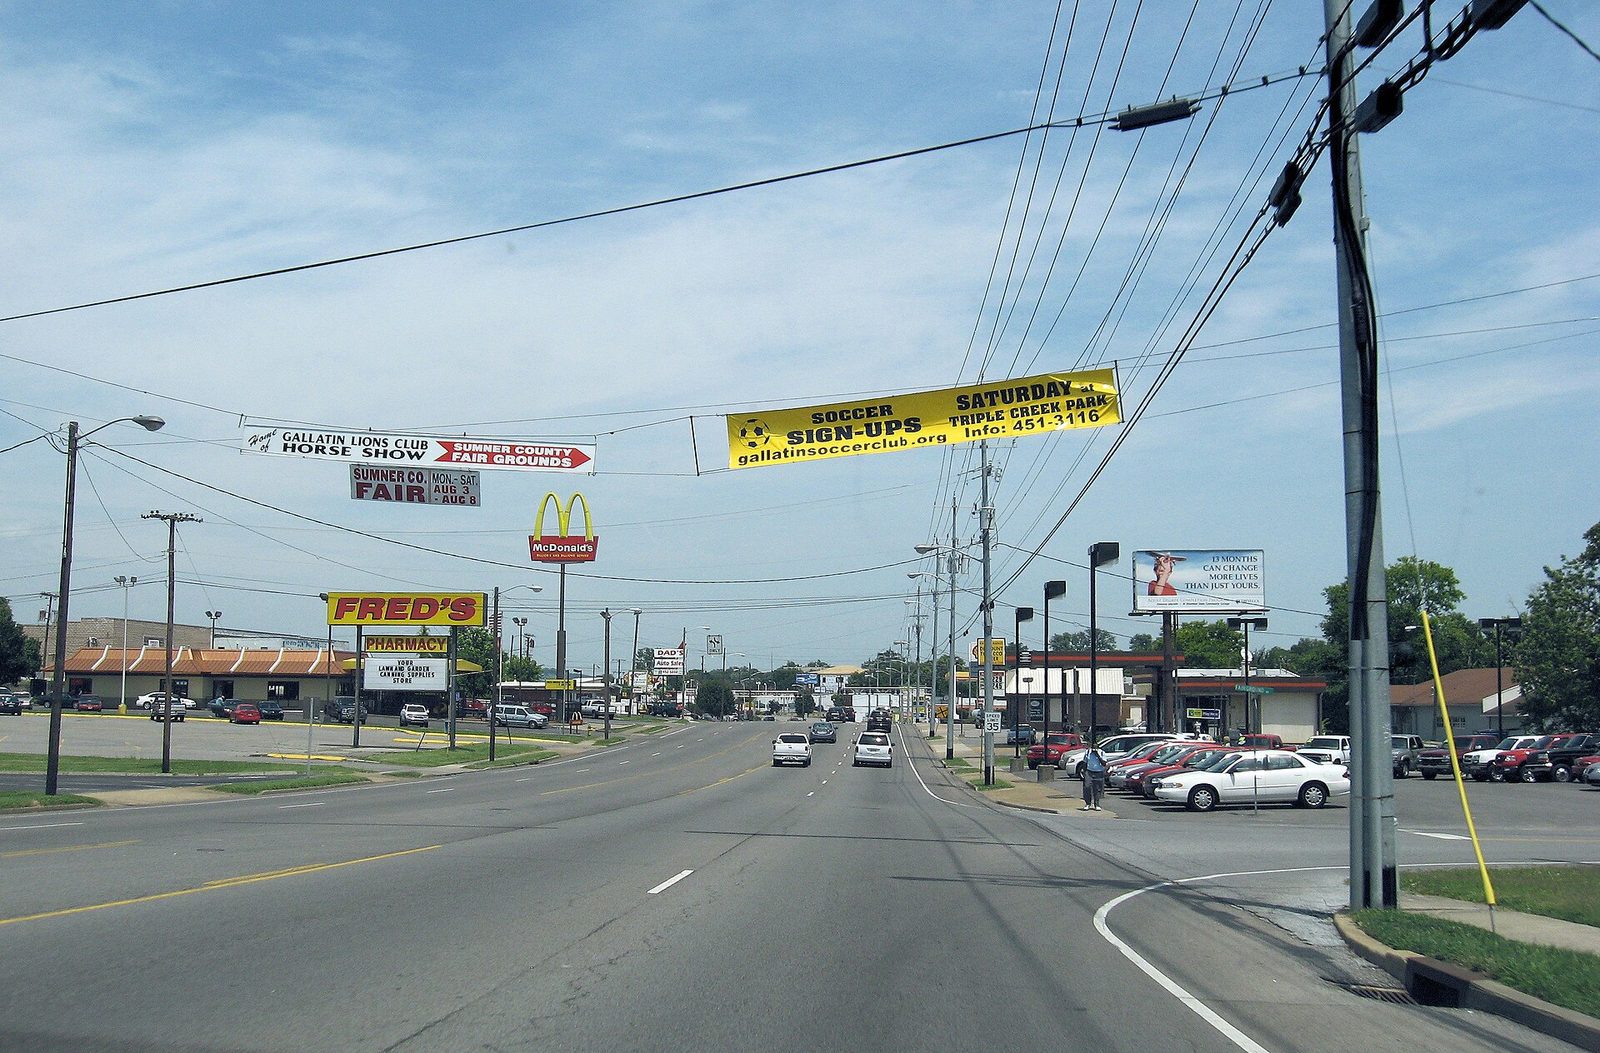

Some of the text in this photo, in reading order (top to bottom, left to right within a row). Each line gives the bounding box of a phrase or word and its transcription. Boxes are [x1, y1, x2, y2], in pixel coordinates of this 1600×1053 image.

[956, 380, 1094, 411] SATURDAY at
[812, 405, 893, 424] SOCCER
[948, 394, 1109, 427] TRIPLE CREEK PARK
[787, 417, 922, 445] SIGN-UPS
[965, 409, 1100, 438] Info: 451-3116
[248, 429, 277, 447] Home
[260, 439, 271, 452] of
[282, 431, 429, 450] GALLATIN LIONS CLUB
[282, 443, 426, 460] HORSE SHOW
[453, 443, 573, 457] SUMNER COUNTY
[738, 433, 947, 466] gallatinsoccerclub.org
[452, 452, 572, 467] FAIR GROUNDS
[353, 467, 428, 484] SUMNER CO.
[356, 482, 426, 503] FAIR
[434, 485, 470, 494] AUG 3
[442, 496, 466, 504] AUG
[469, 496, 477, 505] 8
[533, 543, 593, 552] McDonald's
[1210, 582, 1229, 590] JUST
[334, 597, 477, 621] FRED'S
[366, 638, 447, 650] PHARMACY
[987, 722, 999, 731] 35
